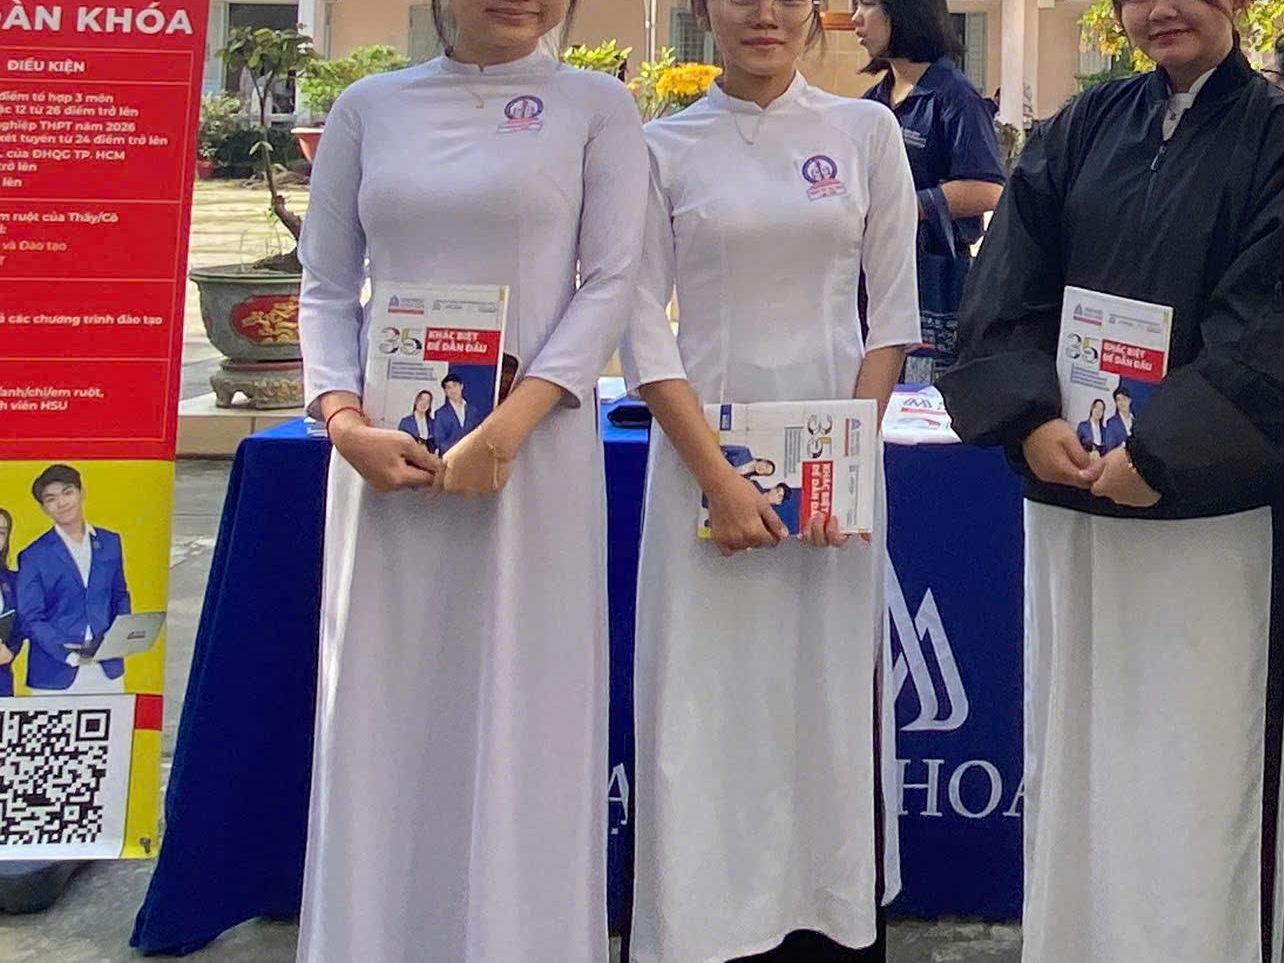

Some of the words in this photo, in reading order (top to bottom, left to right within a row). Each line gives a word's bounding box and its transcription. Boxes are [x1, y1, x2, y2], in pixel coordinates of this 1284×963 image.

[76, 1, 193, 34] KHÓA
[7, 57, 45, 72] ĐIỀU
[48, 59, 85, 75] KIỆN
[75, 93, 83, 103] 3
[85, 93, 114, 104] môn
[15, 106, 26, 115] 12
[119, 106, 139, 118] lên
[40, 120, 73, 132] THPT
[75, 121, 103, 132] năm
[105, 122, 136, 133] 2026
[148, 135, 168, 147] lên
[96, 150, 126, 161] HCM
[18, 161, 37, 172] lên
[40, 400, 68, 411] HSU
